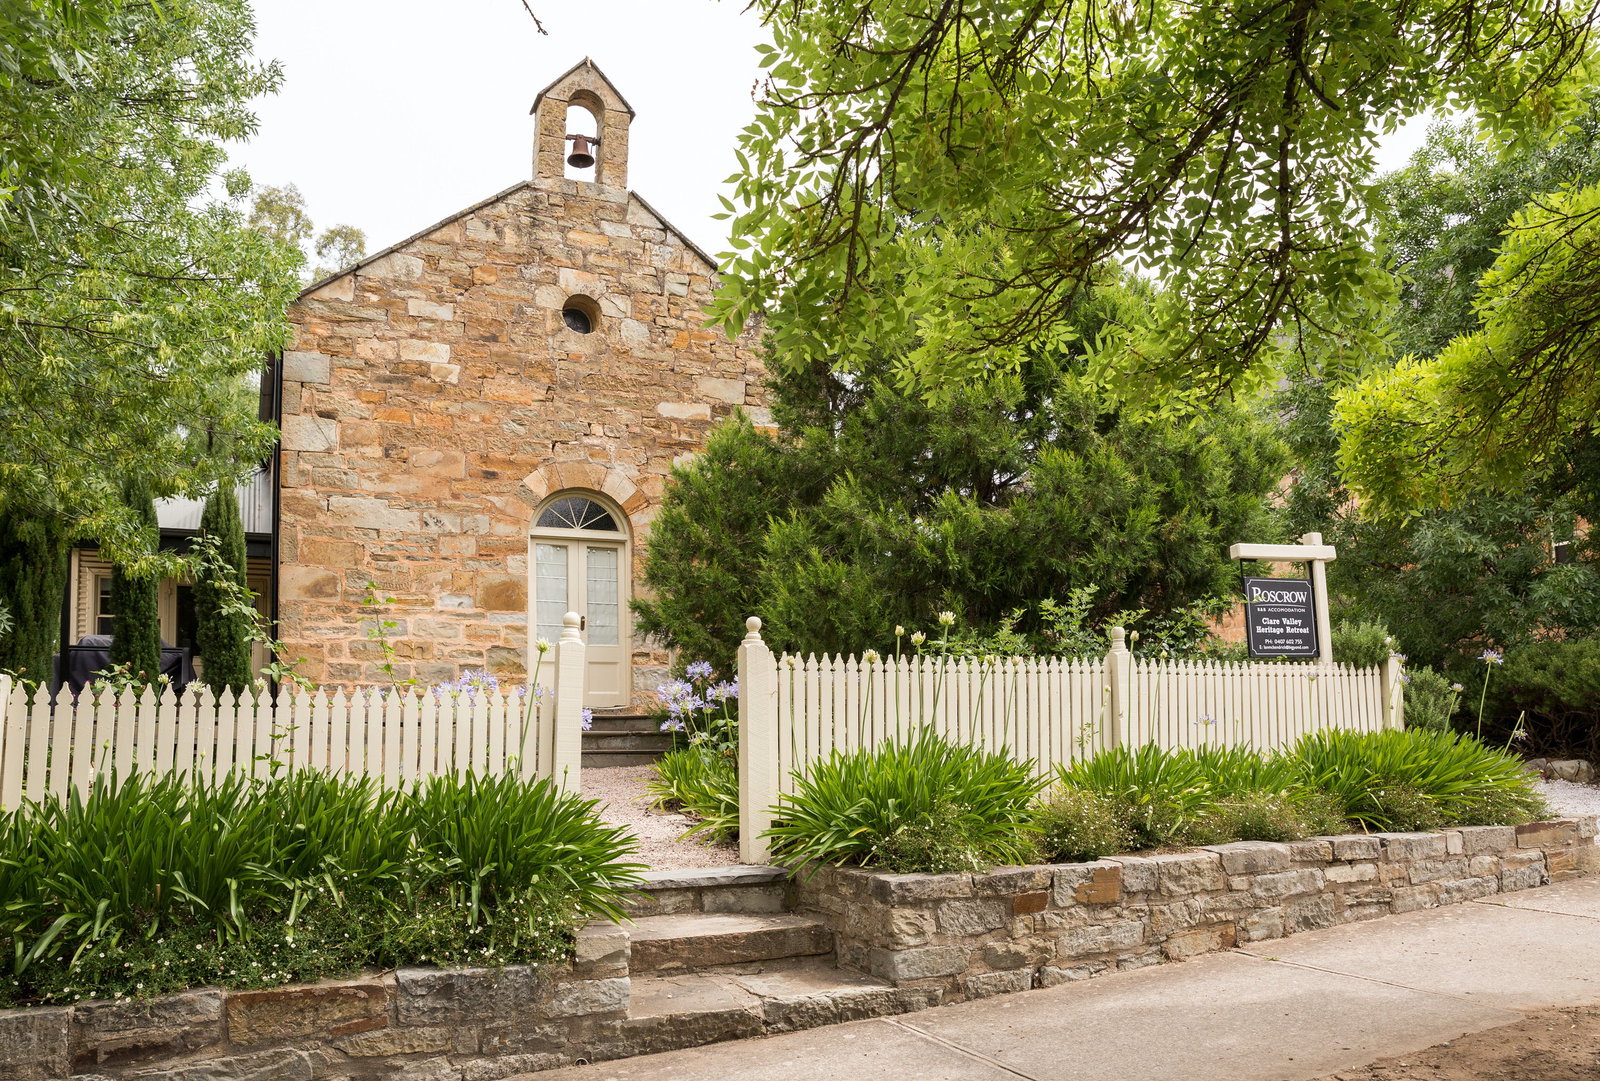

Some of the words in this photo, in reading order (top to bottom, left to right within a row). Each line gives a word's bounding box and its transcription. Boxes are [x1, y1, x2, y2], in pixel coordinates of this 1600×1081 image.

[1251, 587, 1307, 603] ROSCROW
[1261, 617, 1280, 625] Clare
[1282, 617, 1302, 626] Valley
[1256, 626, 1284, 634] Heritage
[1286, 626, 1309, 634] Retreat
